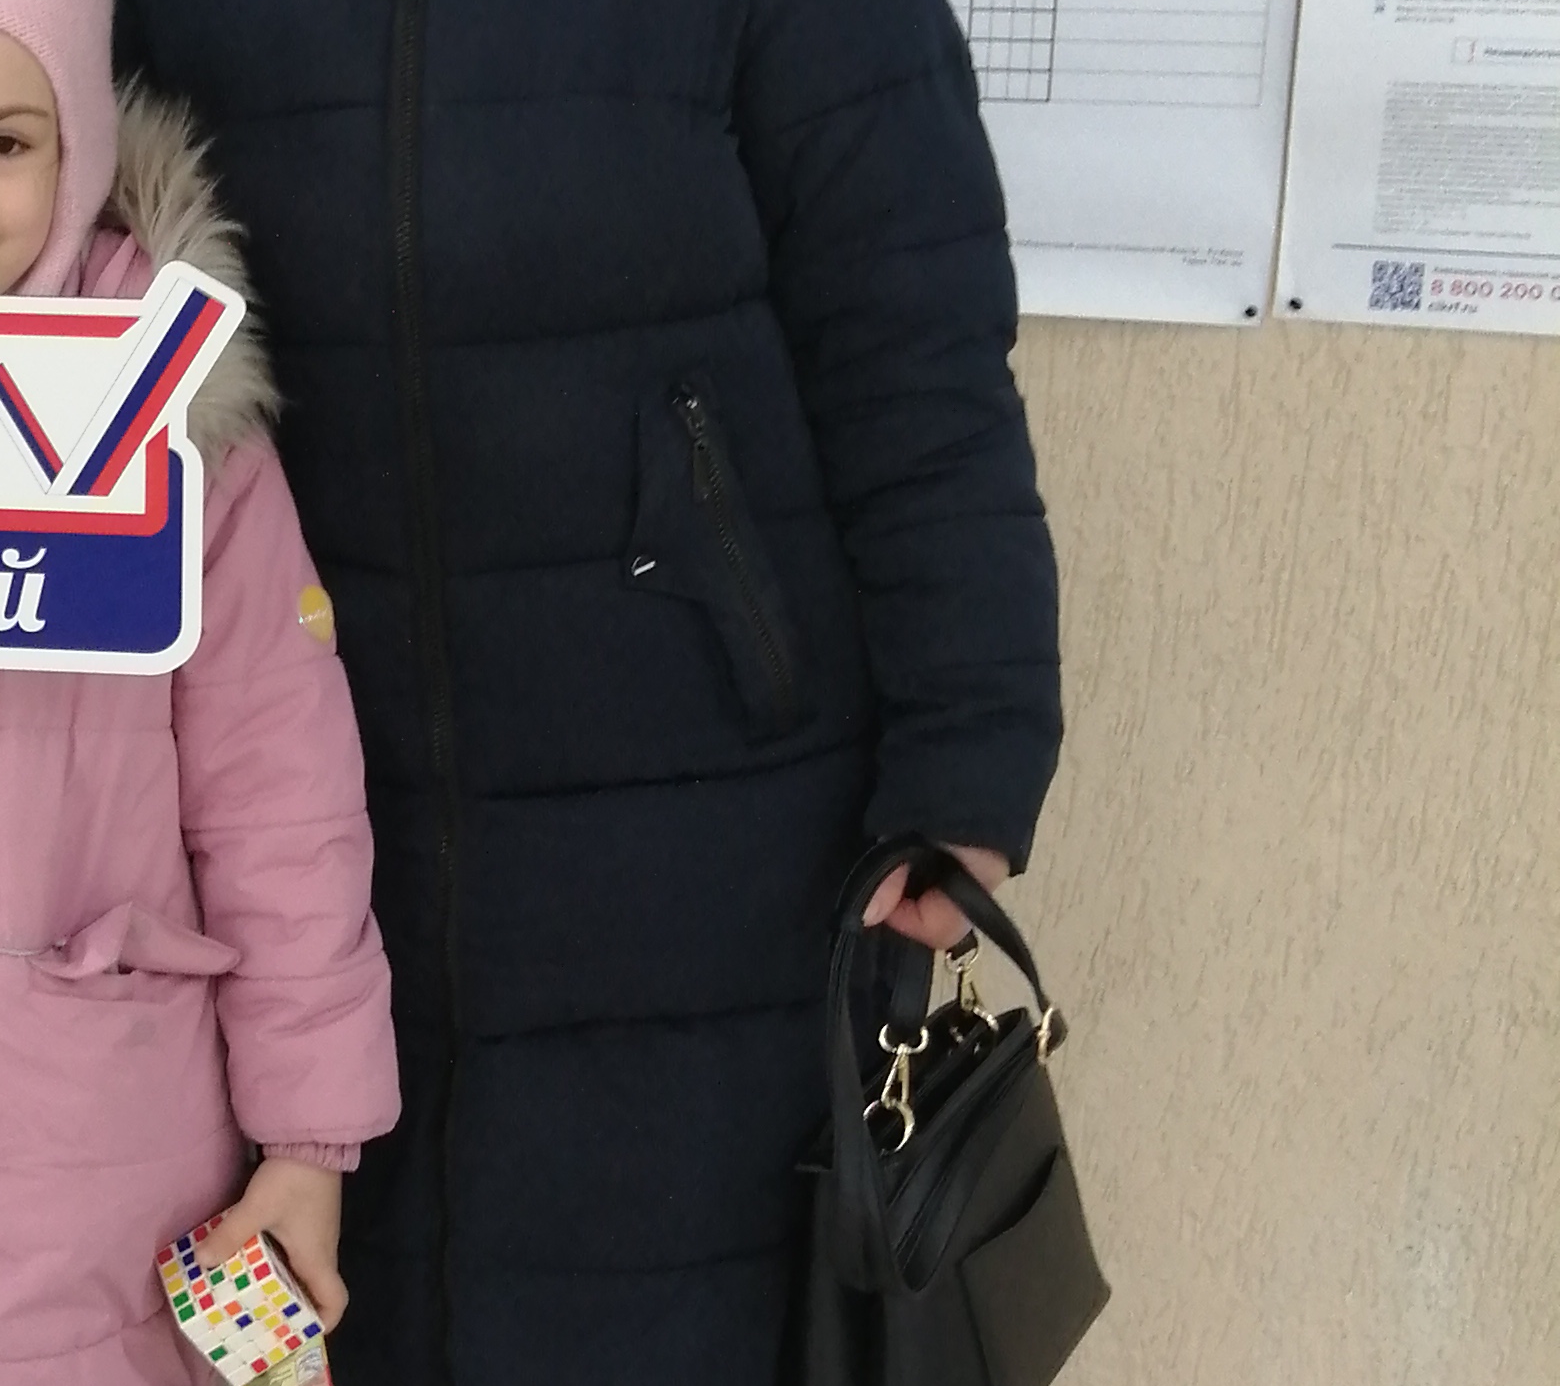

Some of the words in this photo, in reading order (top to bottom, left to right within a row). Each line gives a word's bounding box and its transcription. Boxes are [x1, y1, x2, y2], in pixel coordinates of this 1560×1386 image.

[1430, 278, 1444, 296] 8
[1449, 279, 1494, 299] 800
[1500, 282, 1545, 301] 200
